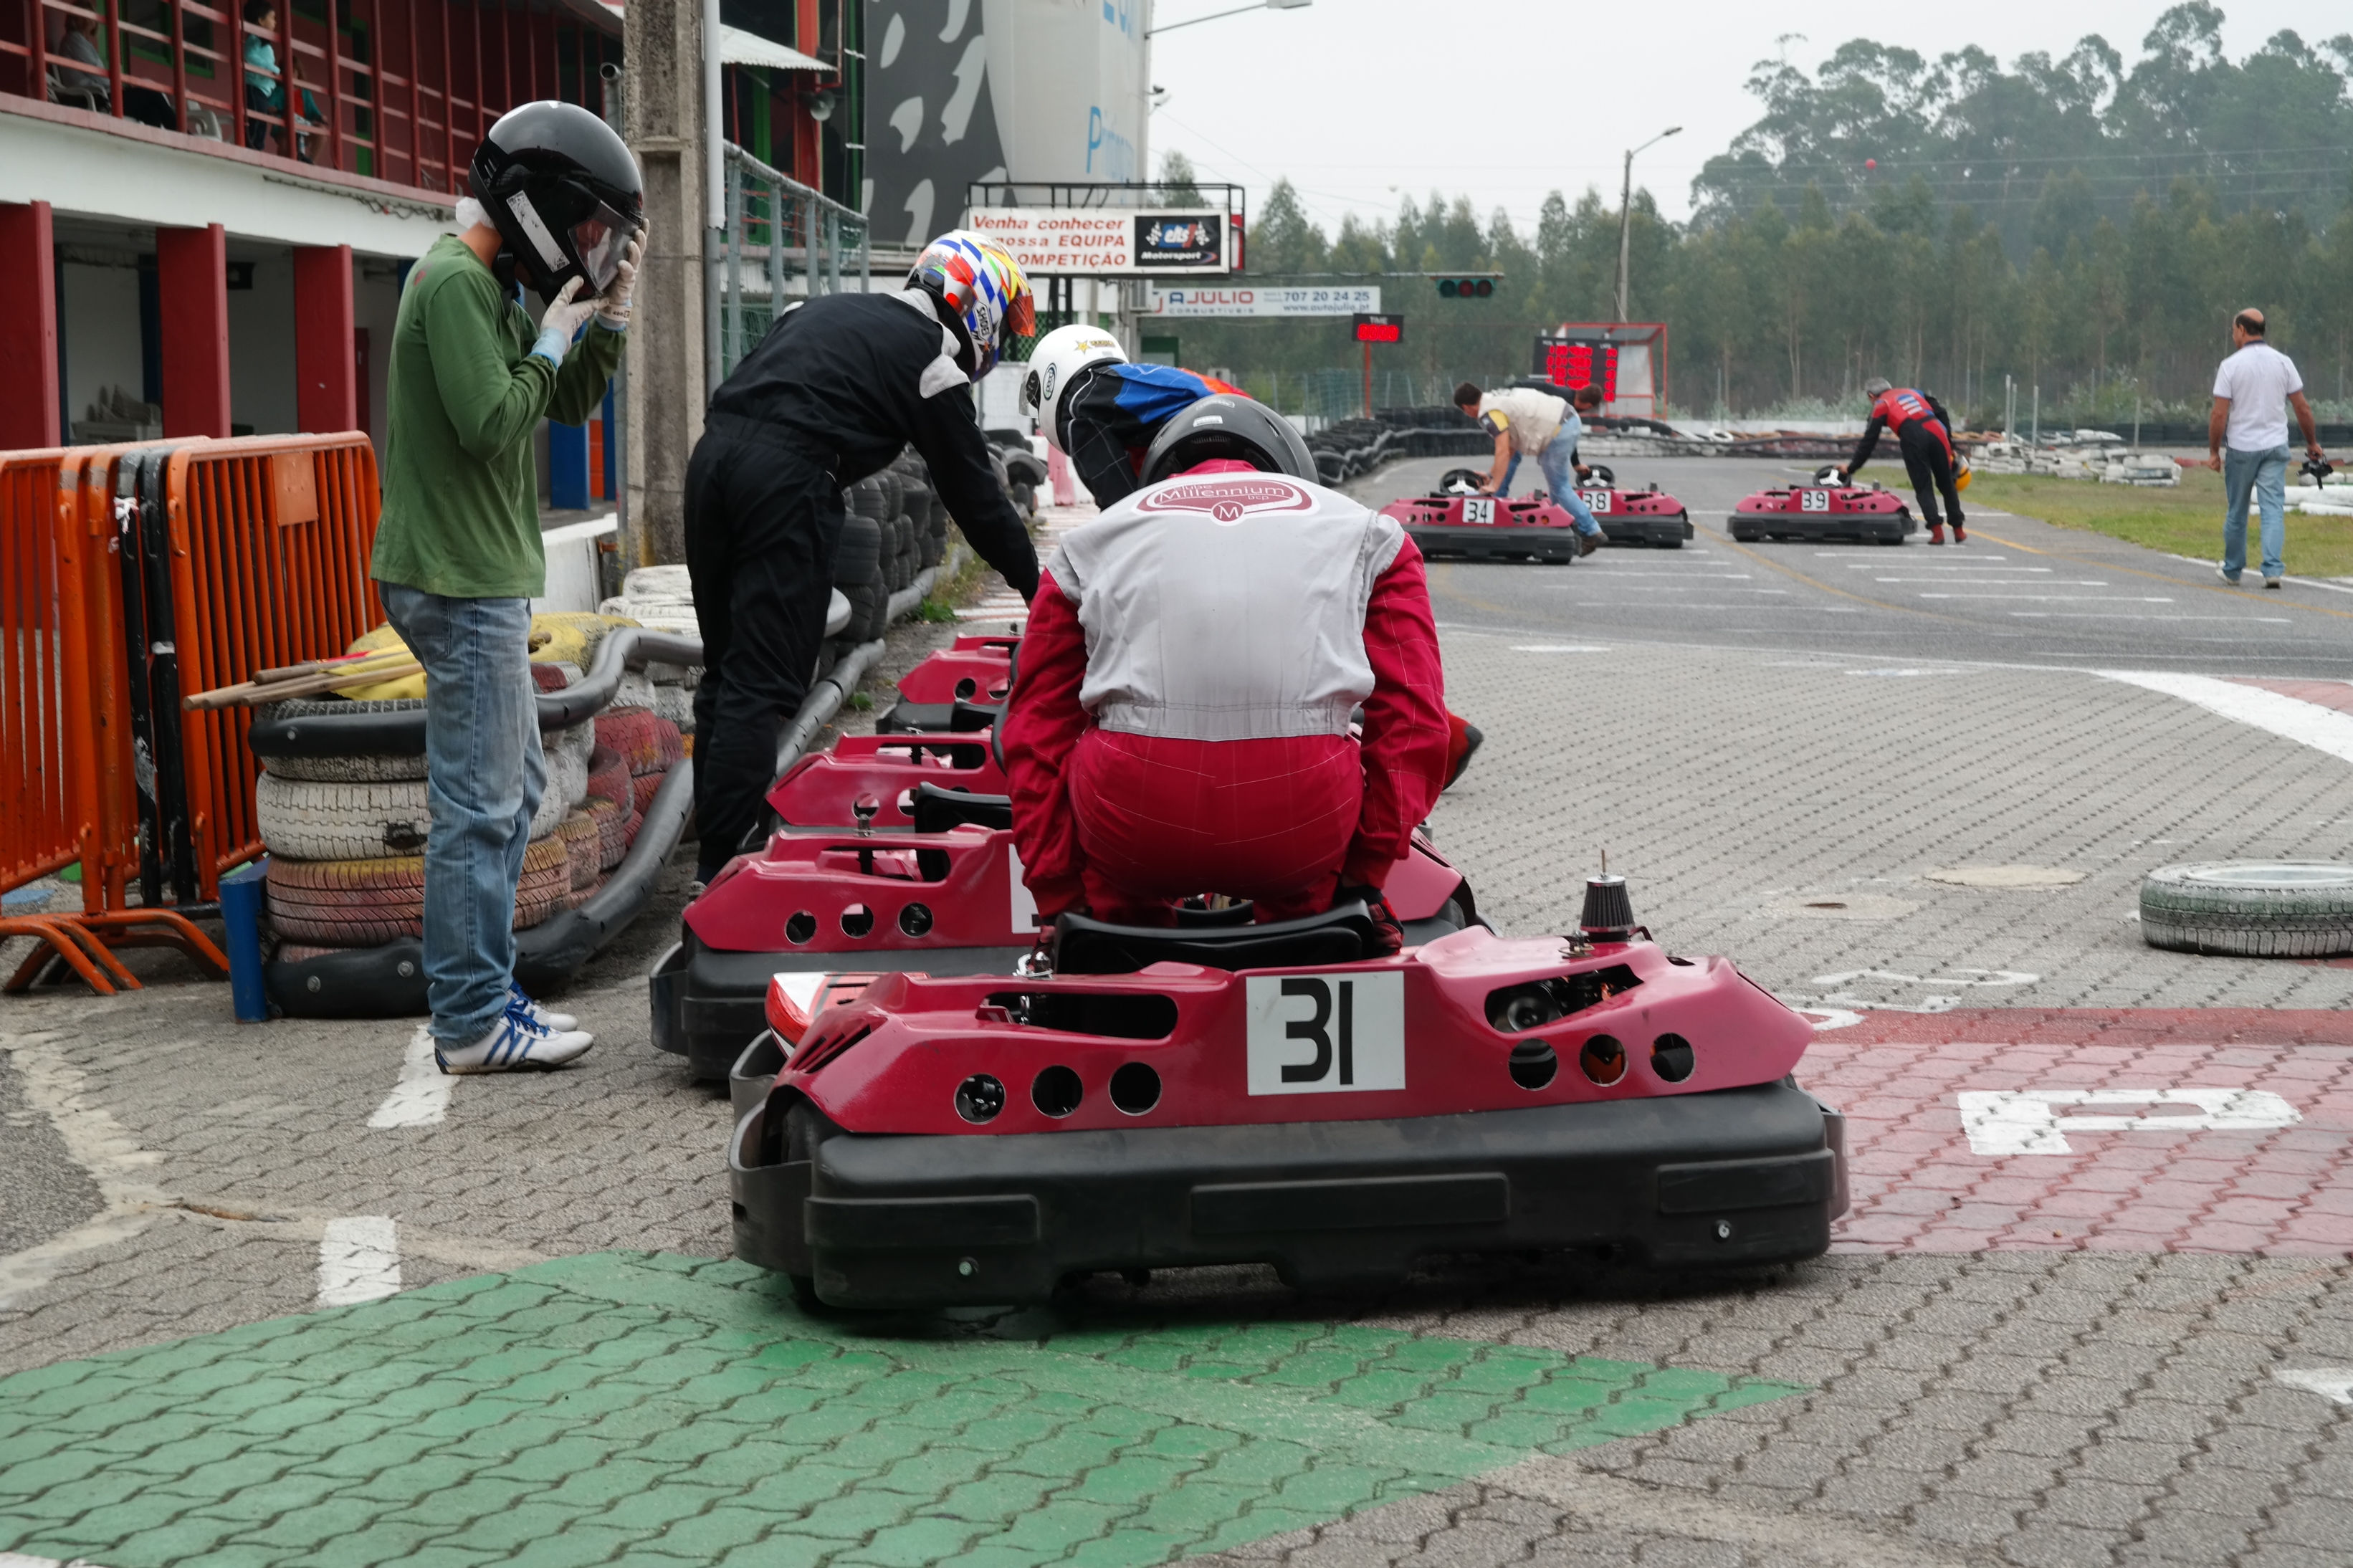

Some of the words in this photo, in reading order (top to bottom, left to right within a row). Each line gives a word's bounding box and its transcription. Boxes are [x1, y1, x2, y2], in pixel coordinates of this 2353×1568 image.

[974, 216, 1028, 229] Venha
[1039, 217, 1125, 230] conhecer
[1059, 234, 1125, 248] EQUIPA
[1018, 253, 1126, 268] OMPETIÇÃO
[1140, 252, 1202, 261] Motorsport
[1284, 292, 1307, 302] 707
[1313, 291, 1328, 302] 20
[1333, 291, 1349, 301] 24
[1354, 291, 1370, 301] 25
[1160, 486, 1284, 502] Millennium
[1584, 493, 1606, 510] 38
[1803, 492, 1825, 509] 39
[1218, 505, 1239, 519] M
[1468, 500, 1487, 523] 34
[1281, 977, 1353, 1085] 31
